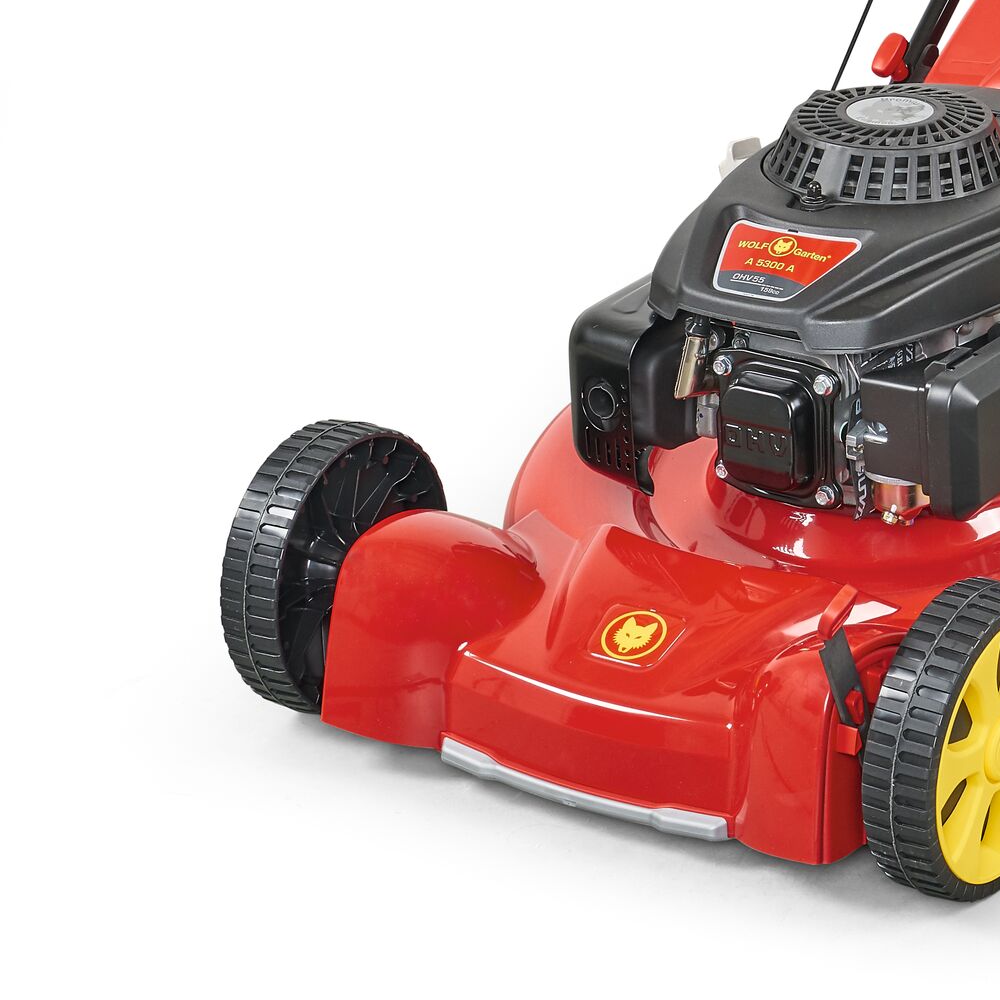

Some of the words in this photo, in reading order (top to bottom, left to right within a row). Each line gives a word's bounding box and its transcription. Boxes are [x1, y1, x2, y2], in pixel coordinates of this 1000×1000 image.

[738, 240, 769, 250] WOLF
[745, 257, 754, 266] A
[755, 259, 785, 270] 5300
[785, 264, 795, 272] A
